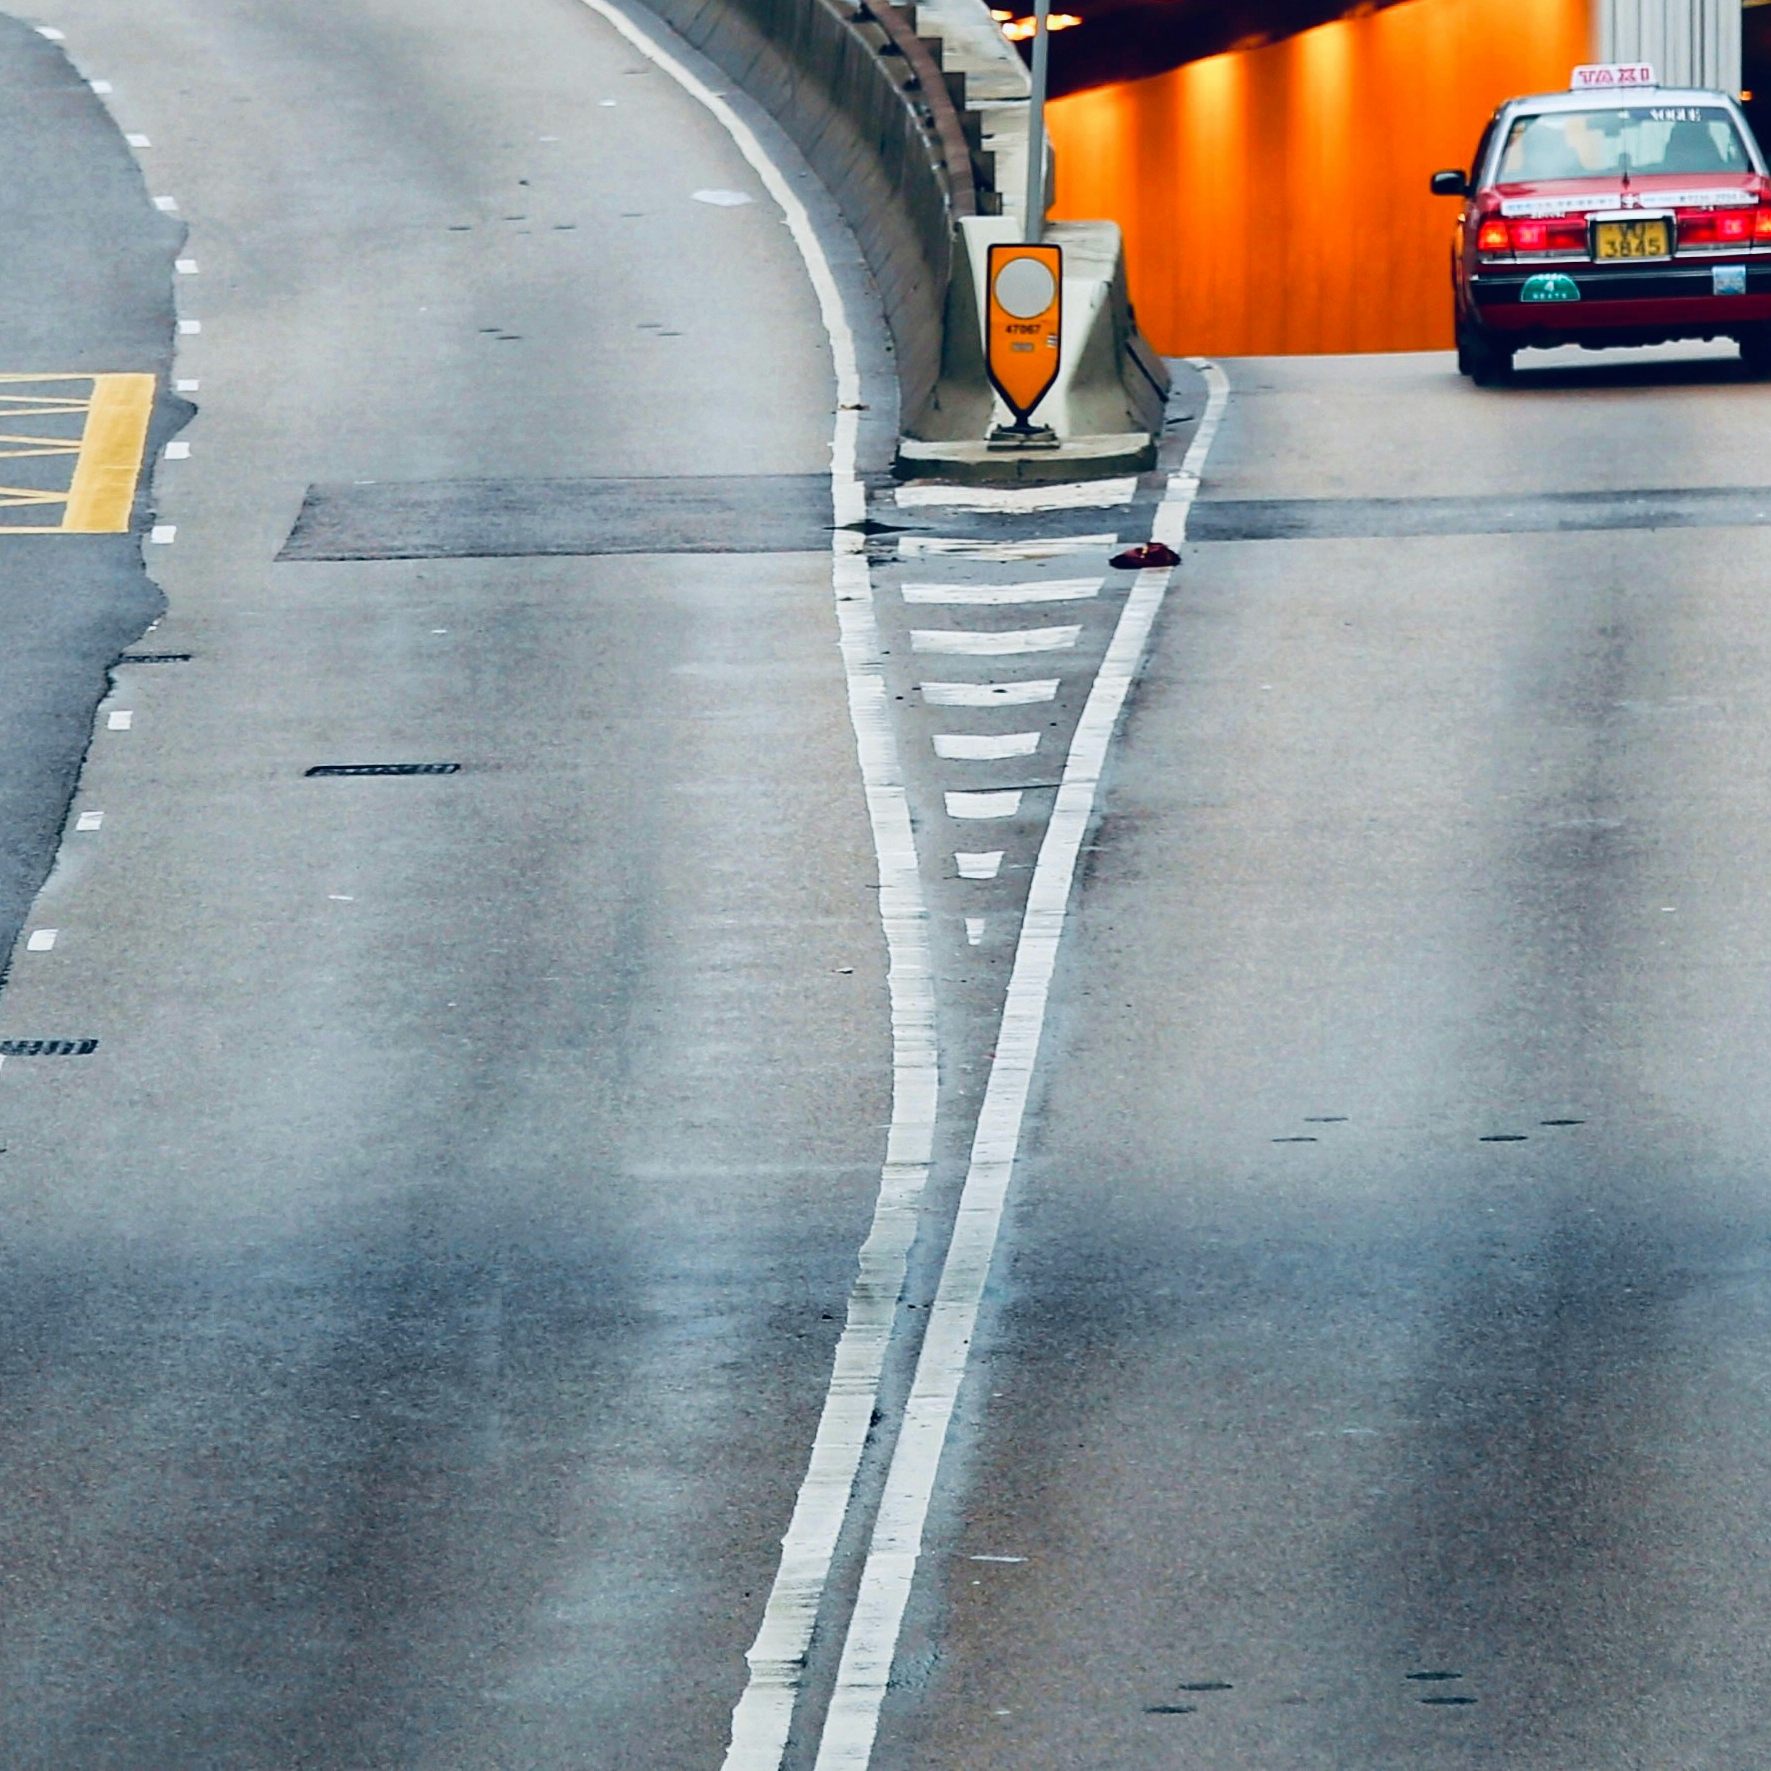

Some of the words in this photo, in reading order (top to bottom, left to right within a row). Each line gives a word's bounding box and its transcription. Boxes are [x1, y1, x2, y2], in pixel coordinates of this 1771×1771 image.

[1579, 67, 1649, 85] TAXI
[1605, 237, 1661, 257] 3845
[1544, 280, 1555, 292] 4
